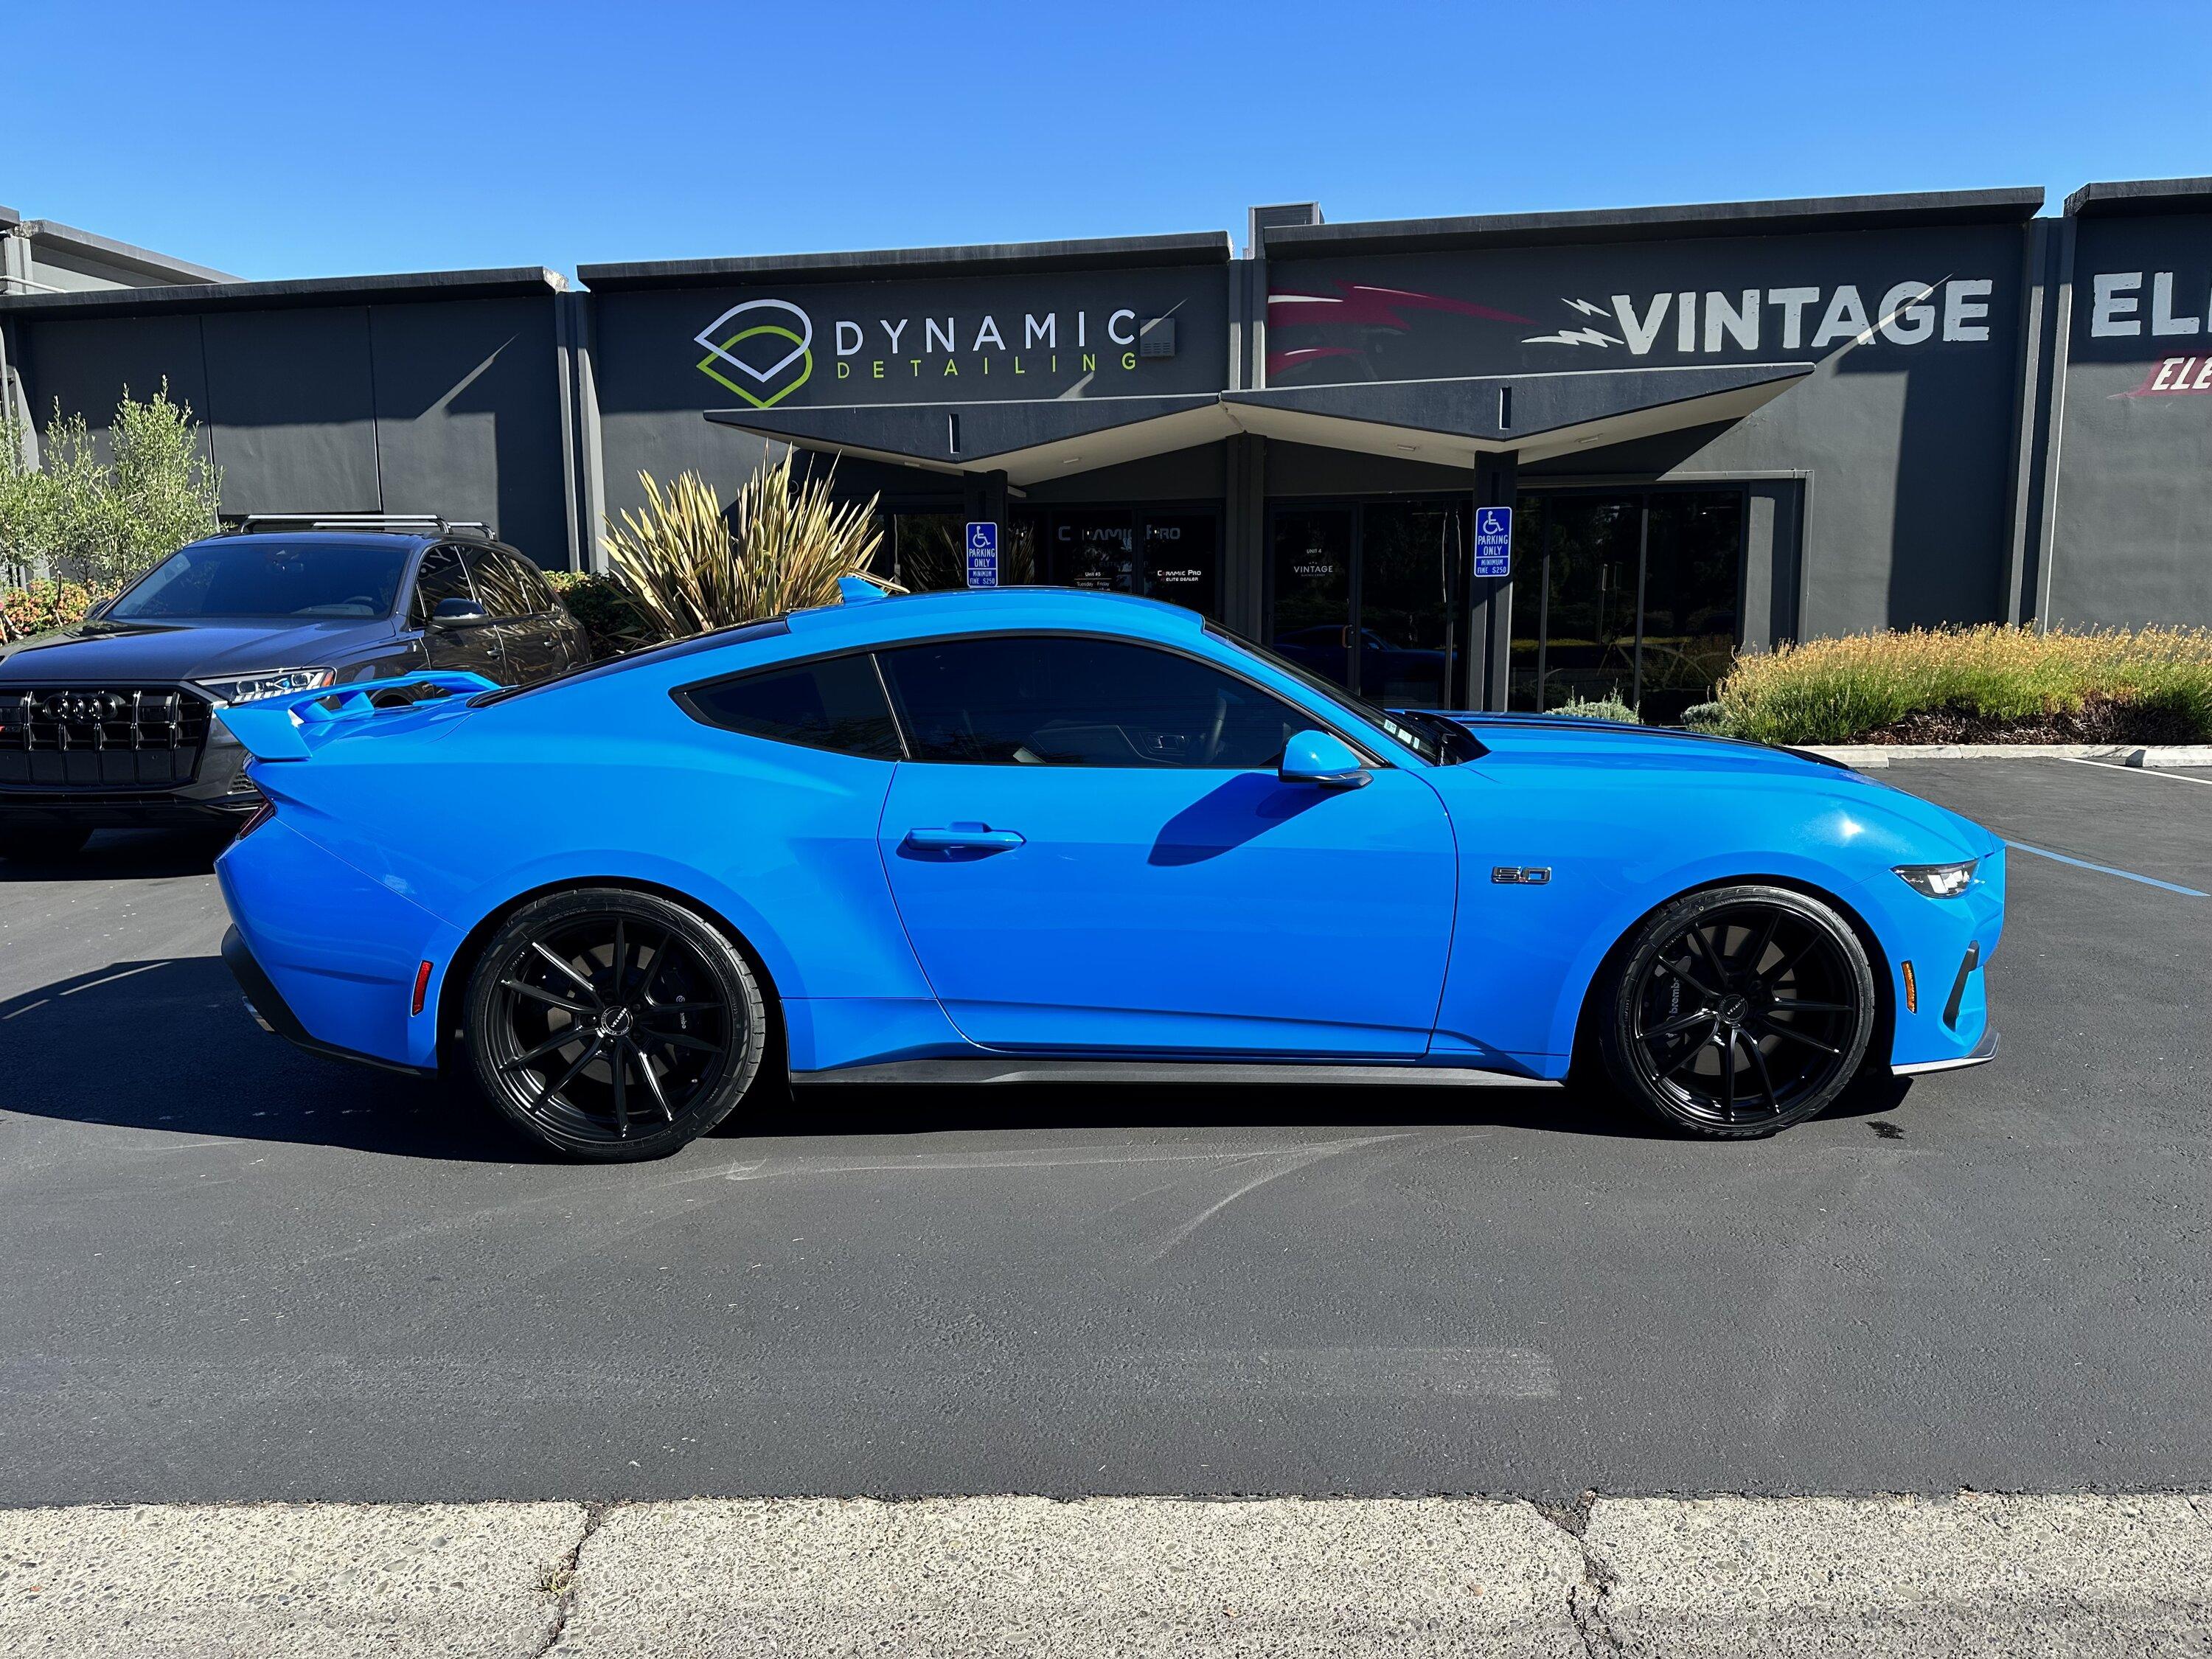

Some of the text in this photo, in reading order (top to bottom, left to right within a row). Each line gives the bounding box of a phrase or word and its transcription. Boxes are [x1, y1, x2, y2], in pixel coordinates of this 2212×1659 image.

[2092, 271, 2212, 338] EL
[1612, 279, 1993, 355] VINTAGE
[835, 309, 1135, 355] DYNAMIC
[837, 352, 1137, 379] DETAILING
[1478, 535, 1509, 545] PARKING
[969, 548, 995, 557] PARKING
[1483, 546, 1502, 556] ONLY
[974, 558, 990, 568] ONLY
[1293, 565, 1334, 573] VINTAGE
[1492, 866, 1552, 885] 5.0
